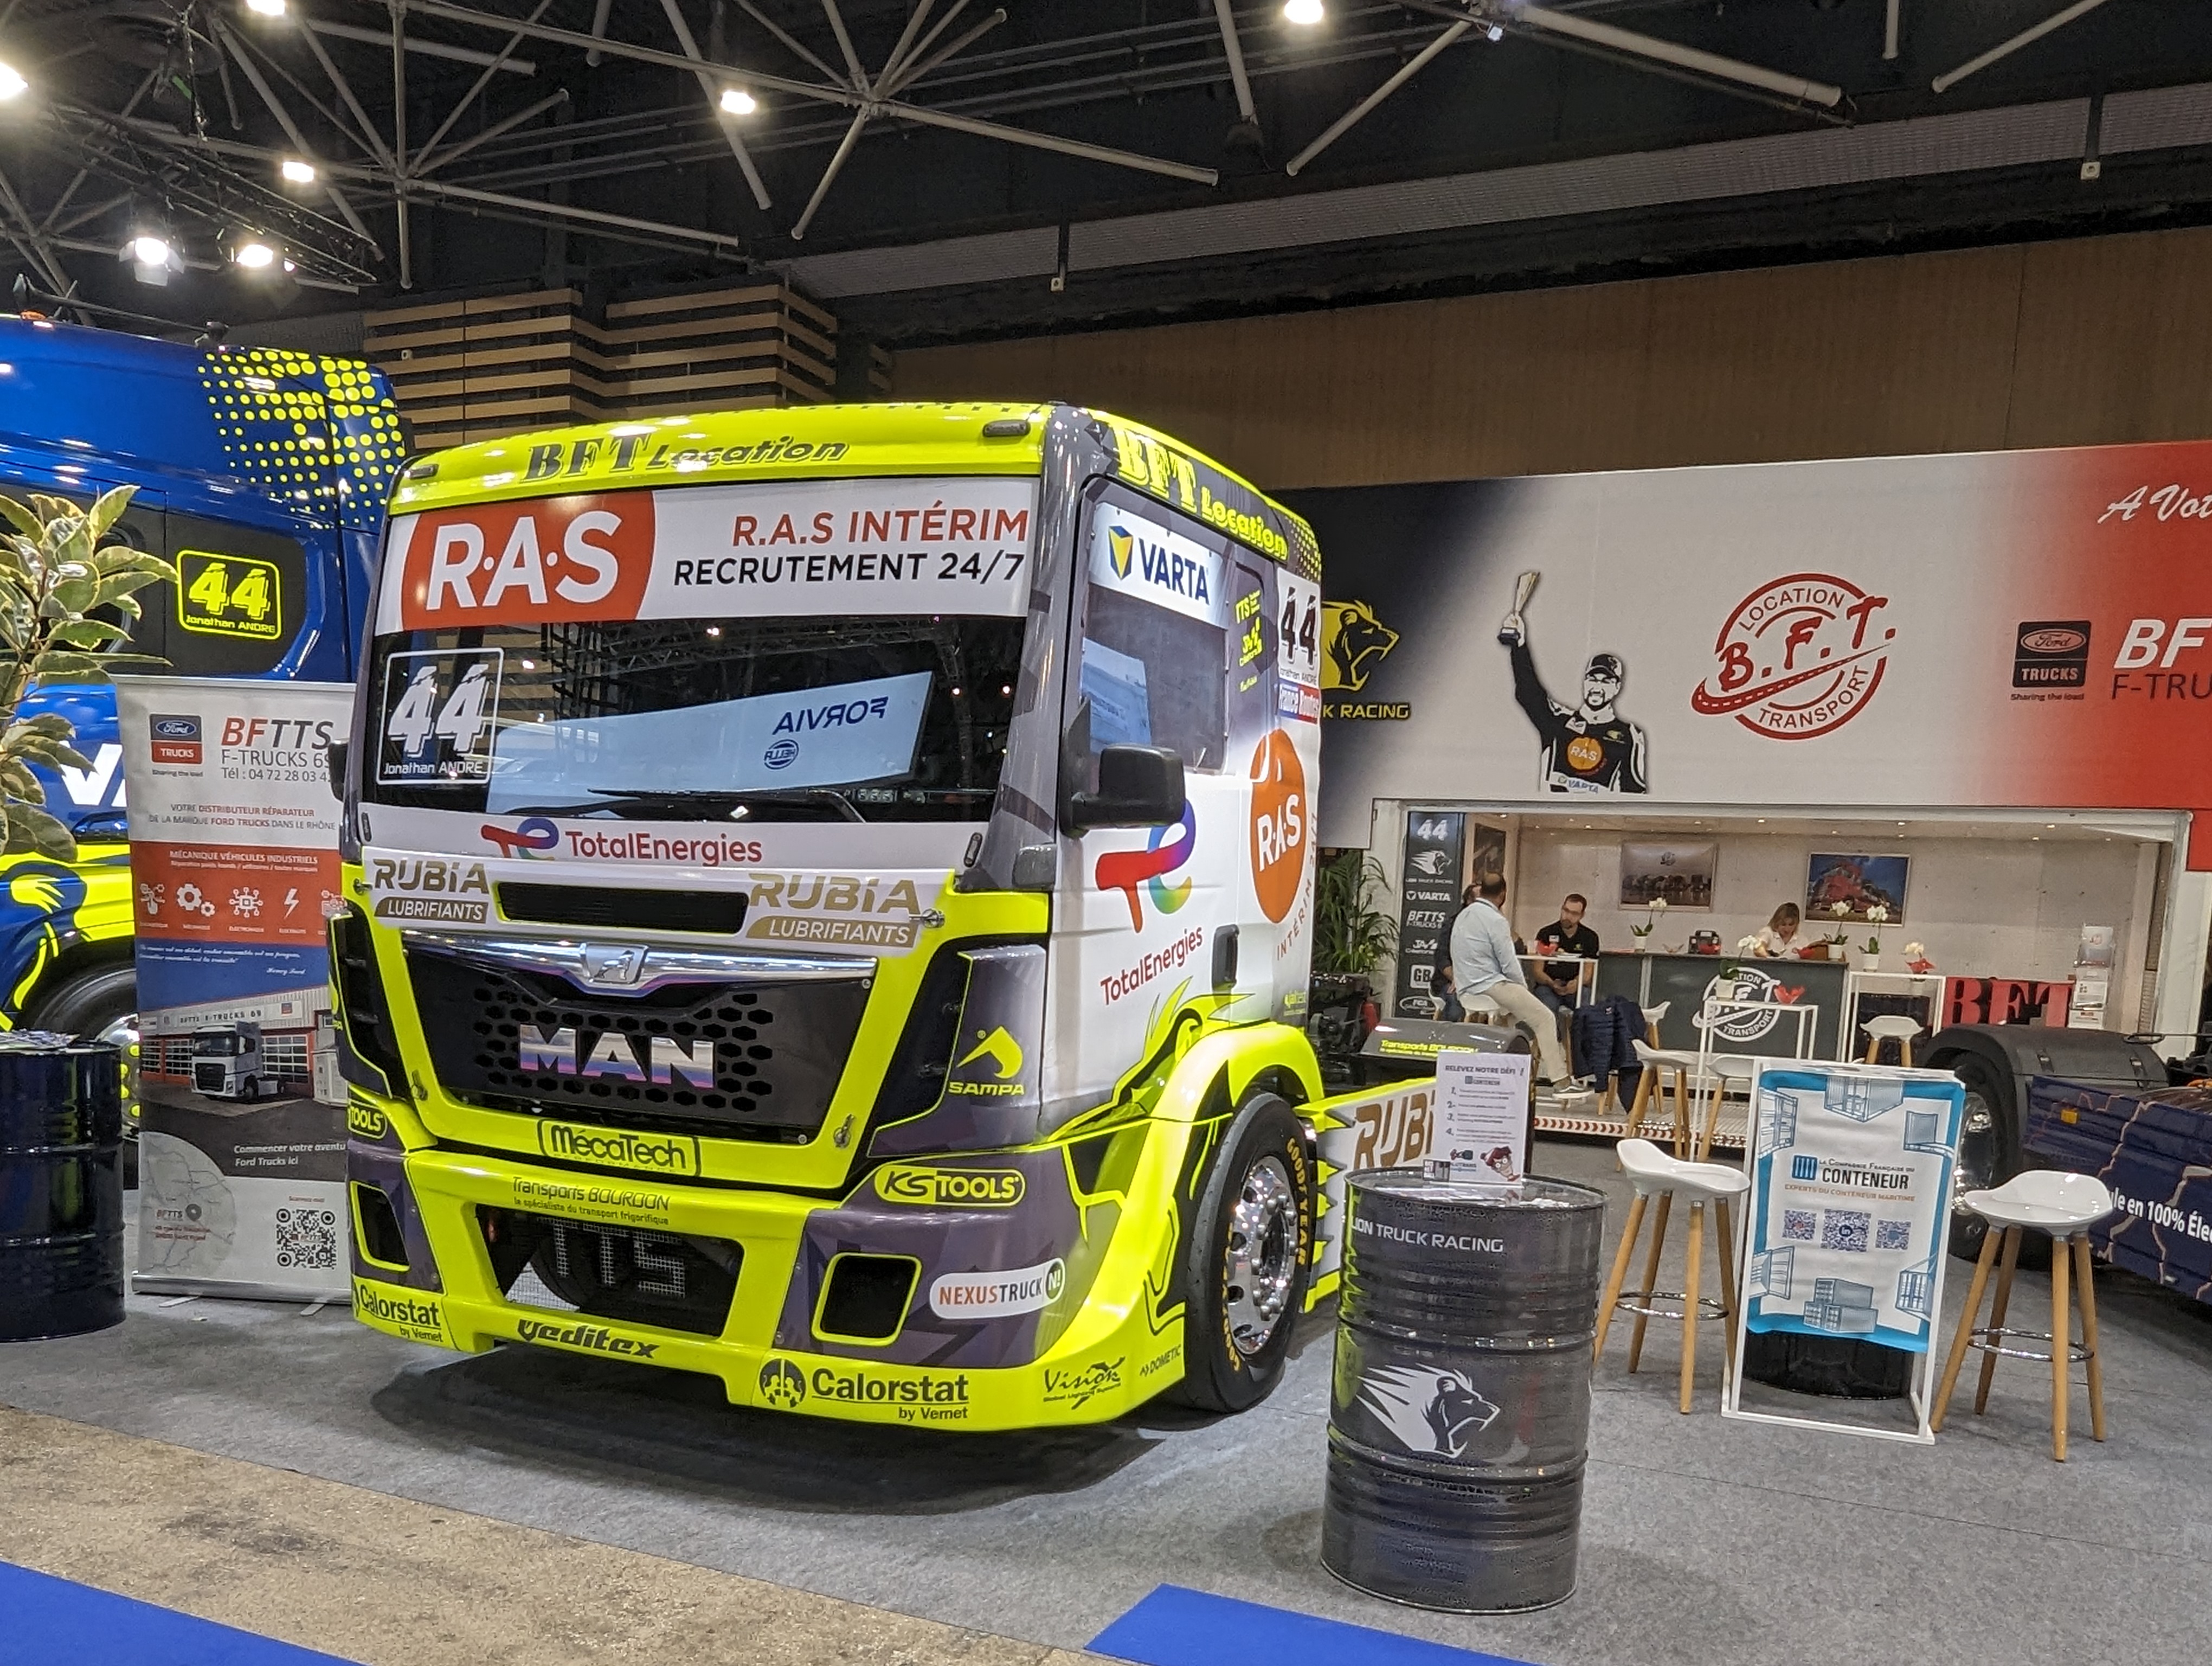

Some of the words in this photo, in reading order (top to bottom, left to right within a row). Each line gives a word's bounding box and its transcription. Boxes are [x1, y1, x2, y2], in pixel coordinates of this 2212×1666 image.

[519, 433, 652, 483] BFT
[645, 435, 850, 470] Location
[2097, 485, 2149, 524] A
[733, 511, 834, 547] R.A.S
[847, 500, 1029, 543] INTÉRIM
[1201, 486, 1289, 560] Location
[673, 552, 928, 586] RECRUTEMENT
[936, 549, 1025, 585] 24/7
[1137, 537, 1211, 605] VARTA
[189, 562, 271, 620] 44
[186, 614, 235, 629] Jonathan
[1739, 588, 1845, 631] LOCATION
[1281, 586, 1317, 670] 44
[2034, 633, 2072, 648] Ford
[1718, 595, 1896, 693] B.F.T.
[2021, 667, 2079, 681] TRUCKS
[1758, 665, 1869, 728] TRANSPORT
[2010, 693, 2045, 702] Sharing
[388, 664, 489, 757] 44
[1340, 704, 1409, 718] RACING
[221, 717, 334, 750] BFTTS
[160, 748, 194, 758] TRUCKS
[221, 749, 307, 767] F-TRUCKS
[221, 767, 239, 779] Tél
[248, 768, 263, 780] 04
[267, 769, 280, 781] 72
[285, 770, 299, 781] 28
[302, 771, 317, 782] 03
[319, 772, 331, 783] 4
[384, 761, 435, 774] Jonathan
[149, 815, 158, 823] DE
[211, 817, 235, 826] FORD
[237, 818, 270, 828] TRUCKS
[271, 819, 294, 829] DANS
[295, 821, 304, 829] LE
[306, 821, 336, 830] RHÔNE
[170, 804, 197, 812] VOTRE
[198, 805, 261, 815] DISTRIBUTEUR
[262, 805, 315, 817] RÉPARATEUR
[1417, 819, 1449, 841] 44
[170, 849, 218, 860] MÉCANIQUE
[221, 851, 265, 862] VÉHICULES
[267, 855, 318, 864] INDUSTRIELS
[565, 830, 762, 867] TotalEnergies
[387, 896, 484, 921] LUBRIFIANTS
[1417, 891, 1451, 901] VARTA
[1408, 910, 1446, 922] BFTTS
[769, 919, 909, 944] LUBRIFIANTS
[1100, 926, 1204, 1005] TotalEnergies
[1723, 1009, 1773, 1036] TRANSPORT
[519, 1024, 714, 1089] MAN
[948, 1081, 1025, 1096] SAMPA
[234, 1145, 288, 1154] Commencer
[551, 1124, 687, 1169] MécaTech
[235, 1158, 256, 1167] Ford
[258, 1157, 286, 1165] Trucks
[1822, 1167, 1909, 1189] CONTENEUR
[513, 1176, 585, 1201] Transports
[588, 1188, 671, 1211] BOURDON
[1784, 1184, 1817, 1193] EXPERTS
[1830, 1189, 1877, 1200] CONTENEUR
[1878, 1193, 1915, 1201] MARITIME
[514, 1196, 521, 1205] le
[523, 1197, 565, 1212] spécialiste
[567, 1204, 577, 1213] du
[579, 1205, 619, 1220] transport
[620, 1210, 670, 1226] frigorifique
[2127, 1198, 2144, 1218] en
[2147, 1200, 2185, 1233] 100%
[1376, 1223, 1433, 1246] TRUCK
[1431, 1234, 1504, 1253] RACING
[939, 1277, 1043, 1305] NEXUSTRUCK
[359, 1284, 441, 1327] Calorstat
[399, 1325, 410, 1338] by
[411, 1327, 443, 1343] Vernet
[1149, 1344, 1181, 1374] DOMETIC
[812, 1367, 969, 1402] Calorstat
[898, 1407, 916, 1421] by
[920, 1407, 969, 1420] Vernet
